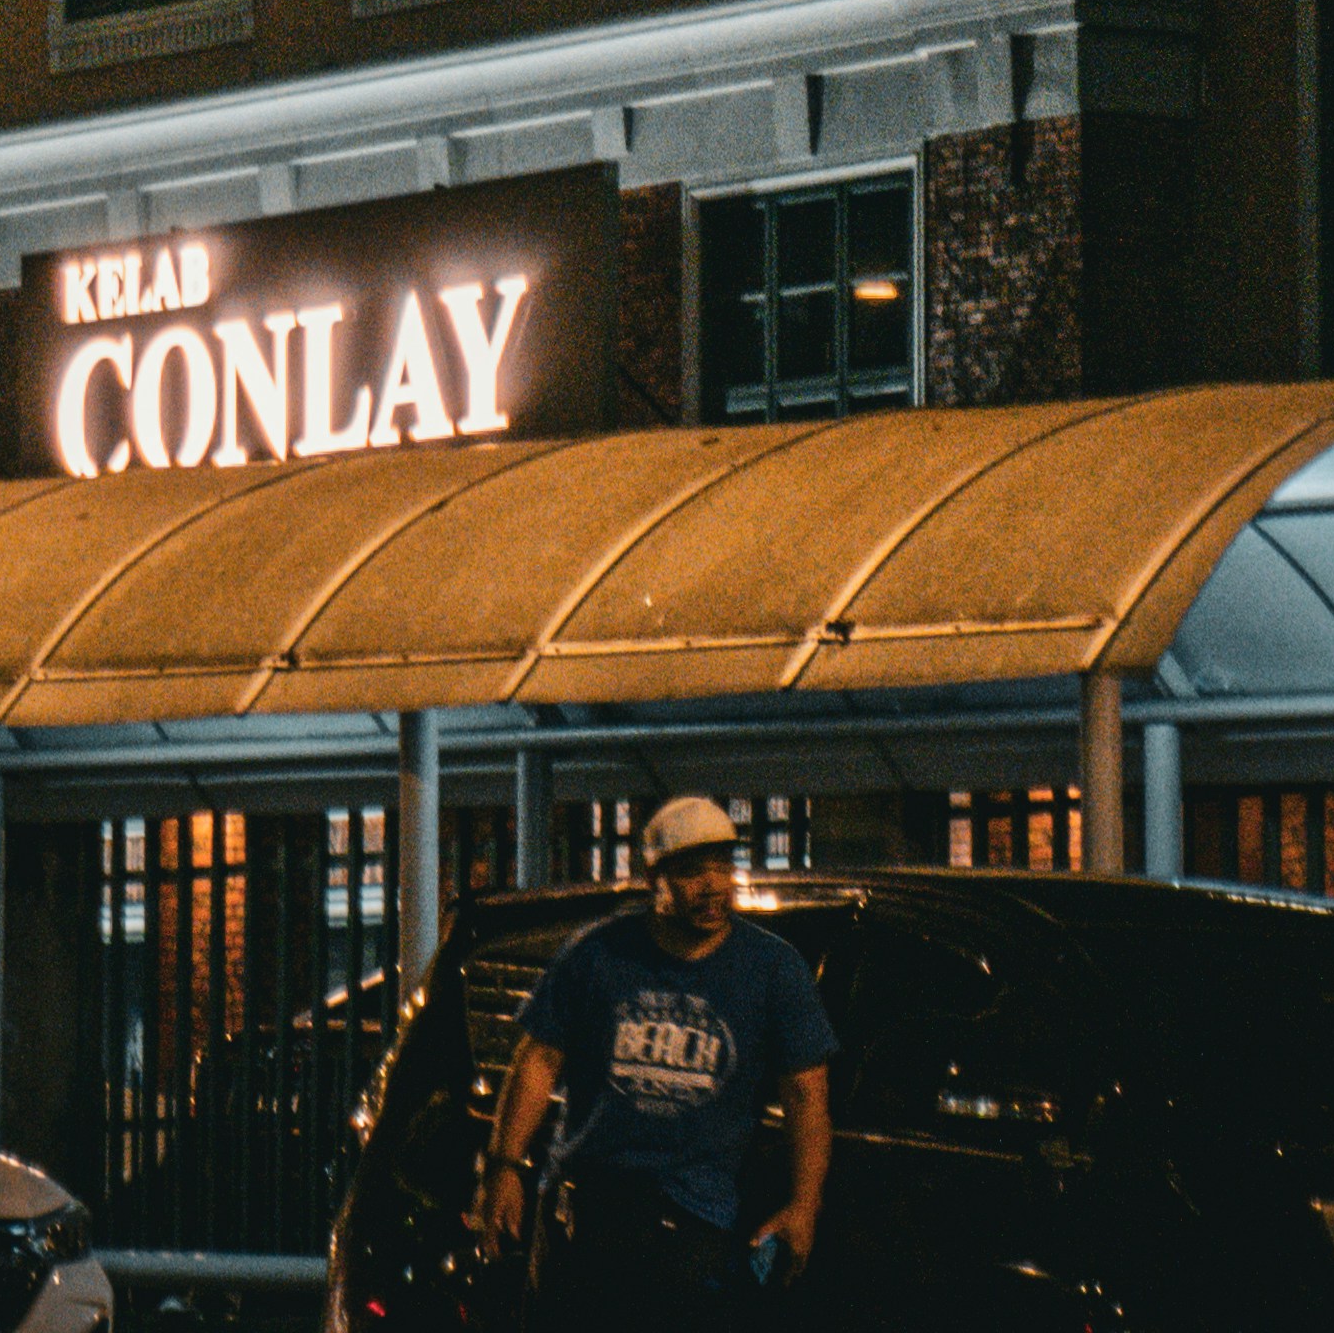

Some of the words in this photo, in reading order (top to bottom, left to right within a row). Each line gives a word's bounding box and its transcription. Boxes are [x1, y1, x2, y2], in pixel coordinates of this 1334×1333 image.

[62, 242, 210, 324] KELAB
[57, 274, 529, 478] CONLAY
[614, 1019, 722, 1073] BEACH
